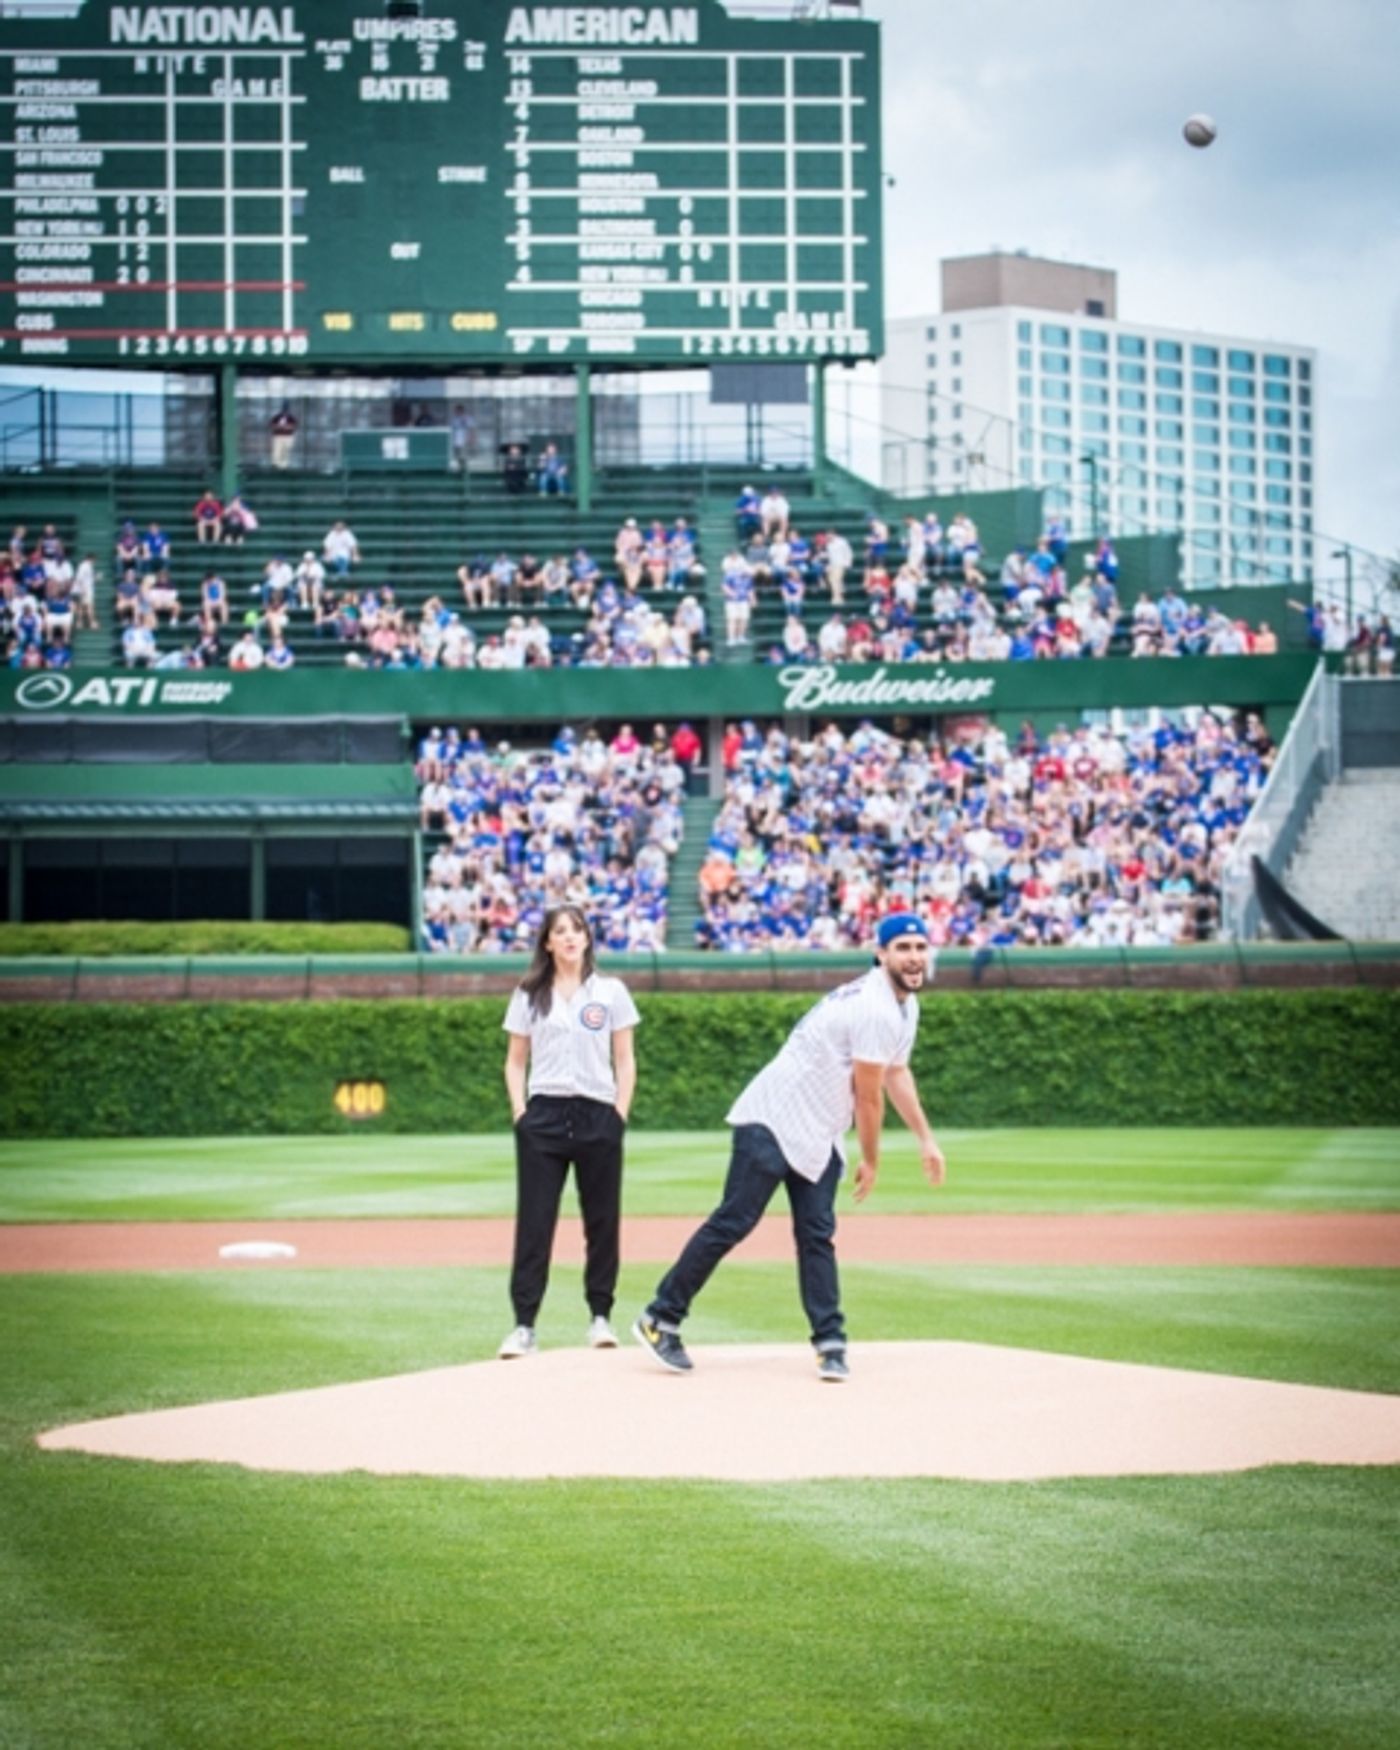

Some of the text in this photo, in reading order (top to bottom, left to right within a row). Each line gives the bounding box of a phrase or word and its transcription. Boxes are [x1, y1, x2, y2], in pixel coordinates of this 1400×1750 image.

[110, 7, 305, 42] NATIONAL
[353, 18, 457, 40] UMPIRES
[504, 9, 698, 43] AMERICAN
[14, 57, 58, 73] MIAMI
[14, 79, 99, 95] PITTSBURGH
[360, 77, 449, 100] BATTER
[15, 102, 76, 119] ARIZONA
[38, 126, 79, 142] LOUIS
[330, 166, 363, 182] BALL
[70, 677, 158, 705] ATI
[777, 665, 995, 710] Budweiser
[335, 1082, 385, 1113] 400
